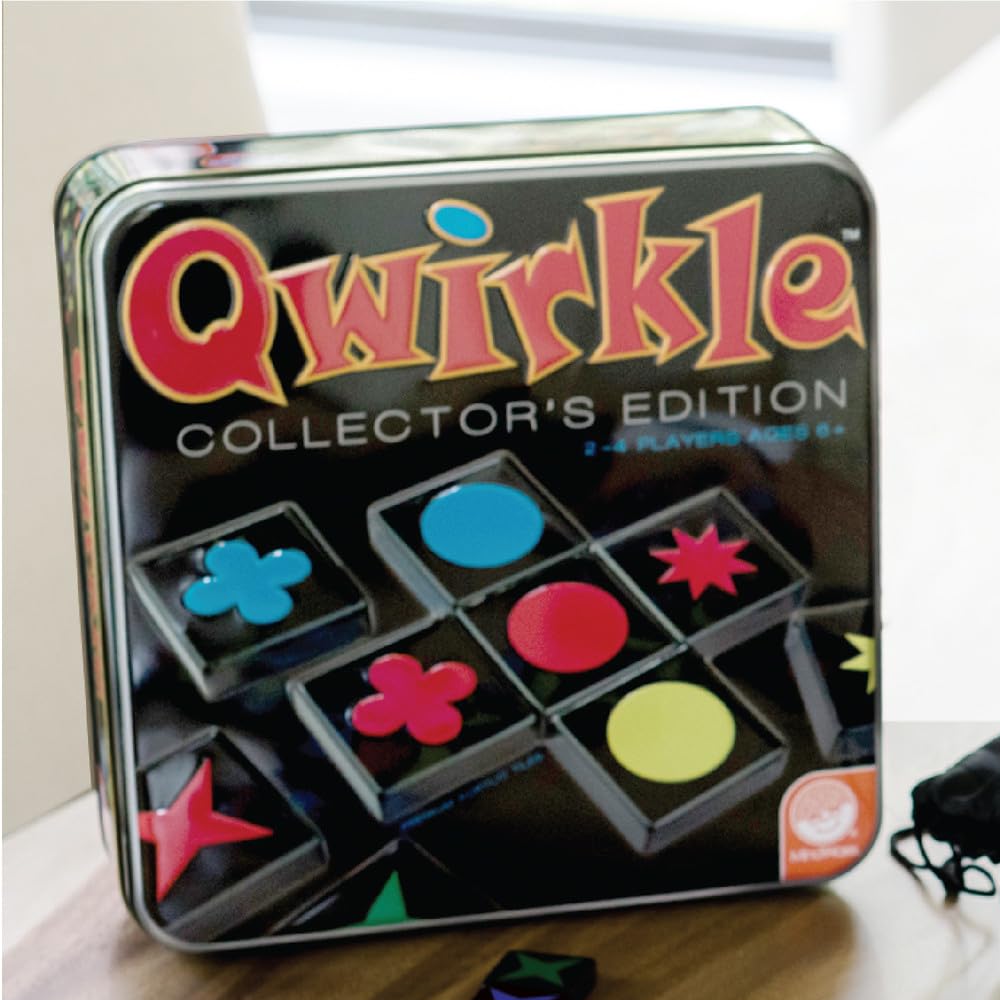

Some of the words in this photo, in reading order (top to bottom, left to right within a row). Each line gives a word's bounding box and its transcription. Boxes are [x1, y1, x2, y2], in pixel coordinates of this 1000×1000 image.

[122, 187, 866, 406] Qwirkle
[177, 396, 595, 457] COLLECTOR'S
[622, 378, 847, 426] EDITION
